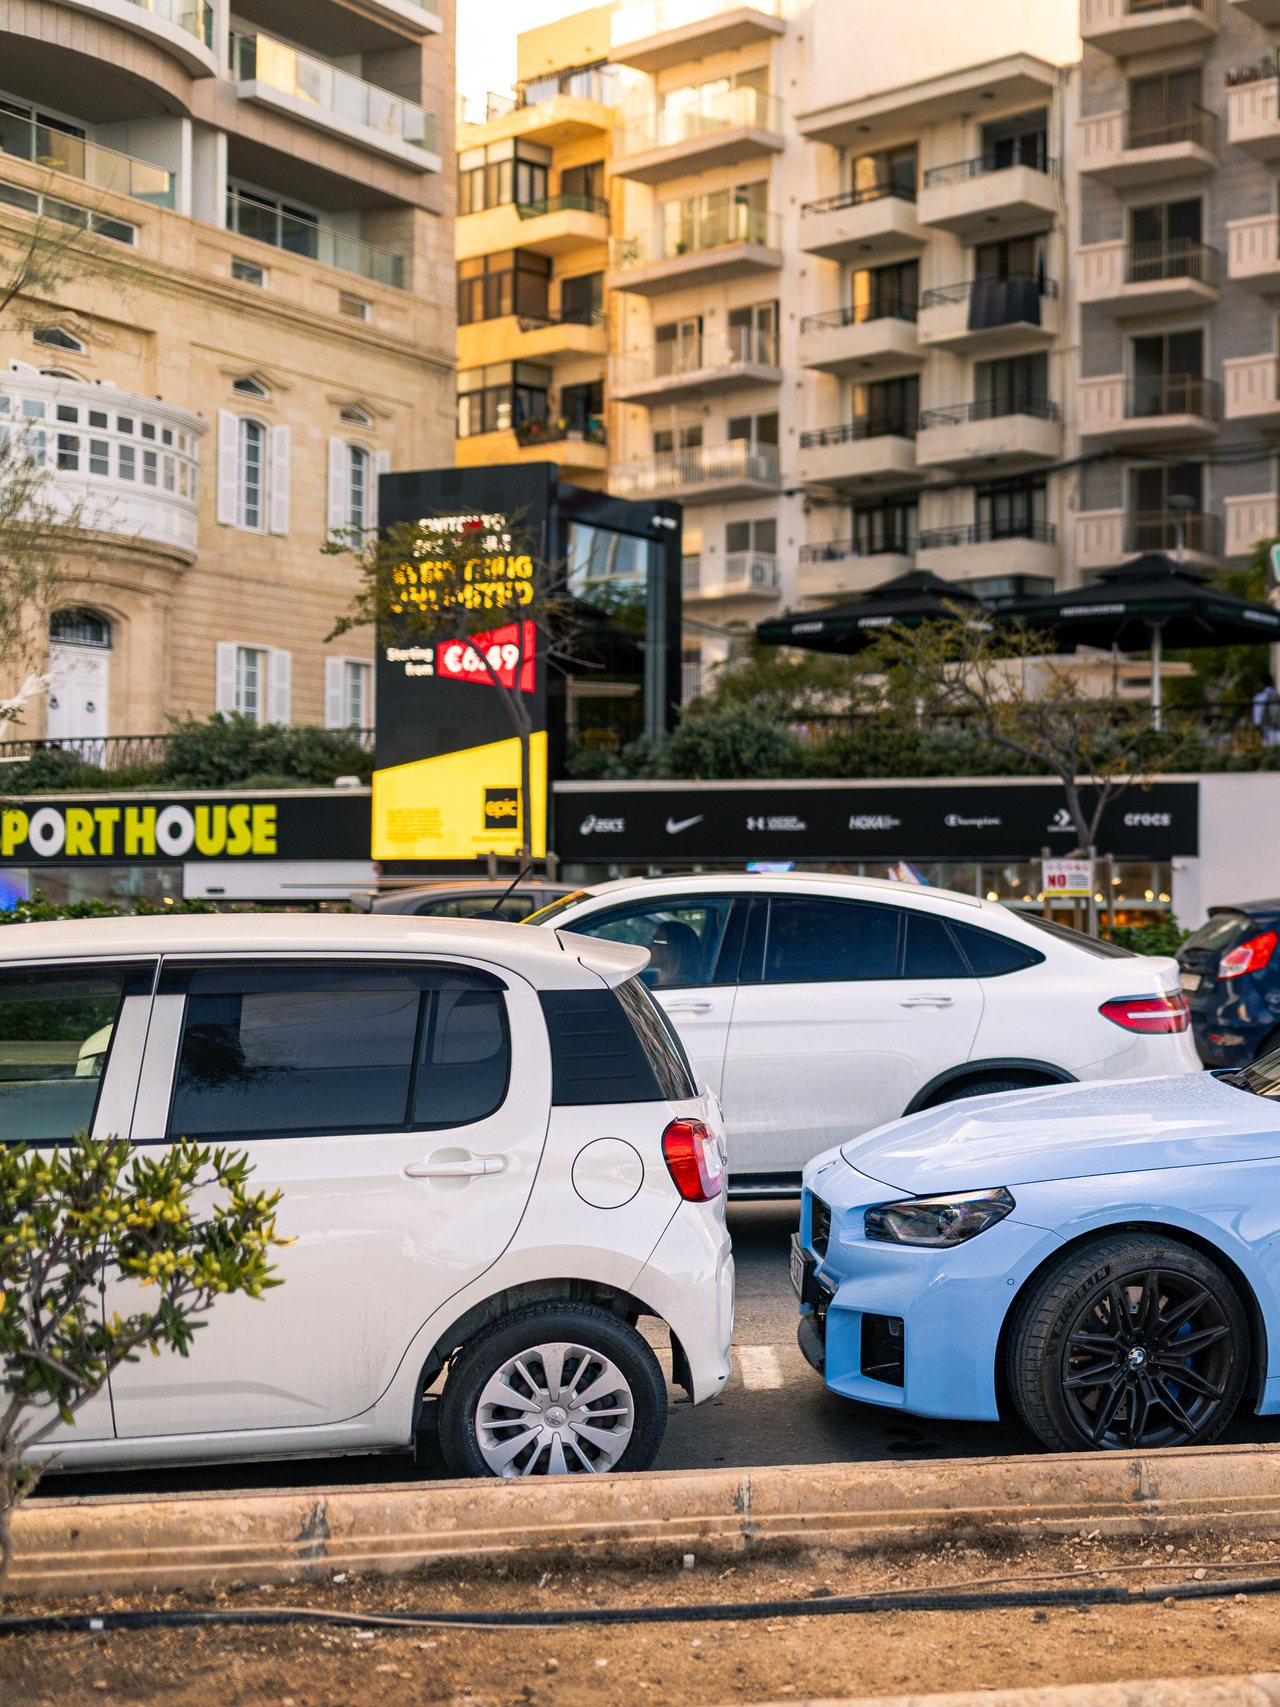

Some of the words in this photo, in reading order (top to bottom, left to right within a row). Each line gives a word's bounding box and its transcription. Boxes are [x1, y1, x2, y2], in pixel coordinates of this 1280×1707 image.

[386, 646, 434, 663] Starting
[444, 643, 520, 672] €6.49
[405, 662, 434, 676] from
[485, 798, 517, 818] epic
[1124, 813, 1171, 827] crocs
[0, 807, 120, 857] PORT
[1048, 874, 1067, 888] NO
[1053, 1267, 1109, 1334] MICHELIN
